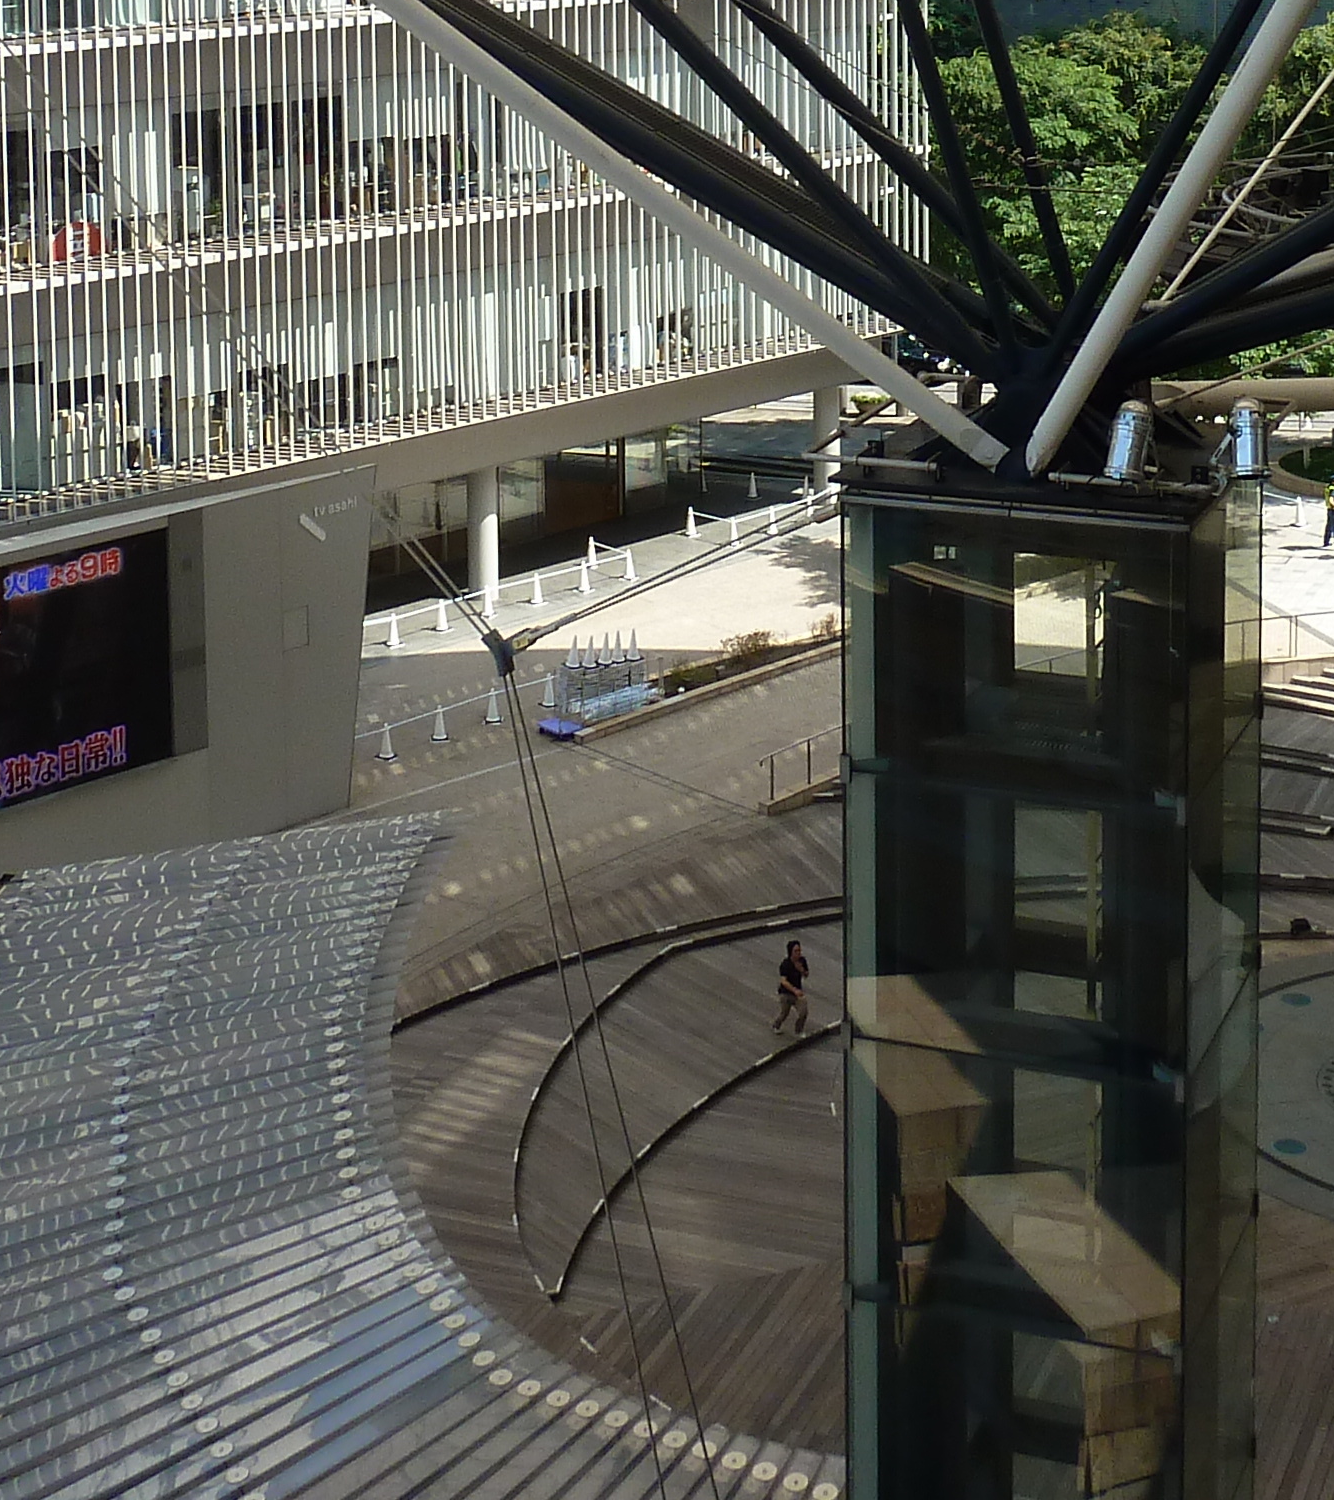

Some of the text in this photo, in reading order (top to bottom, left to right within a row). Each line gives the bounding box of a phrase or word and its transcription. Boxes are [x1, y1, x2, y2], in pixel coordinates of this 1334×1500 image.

[313, 495, 358, 518] tv asahi
[3, 548, 124, 600] 火曜よる9時
